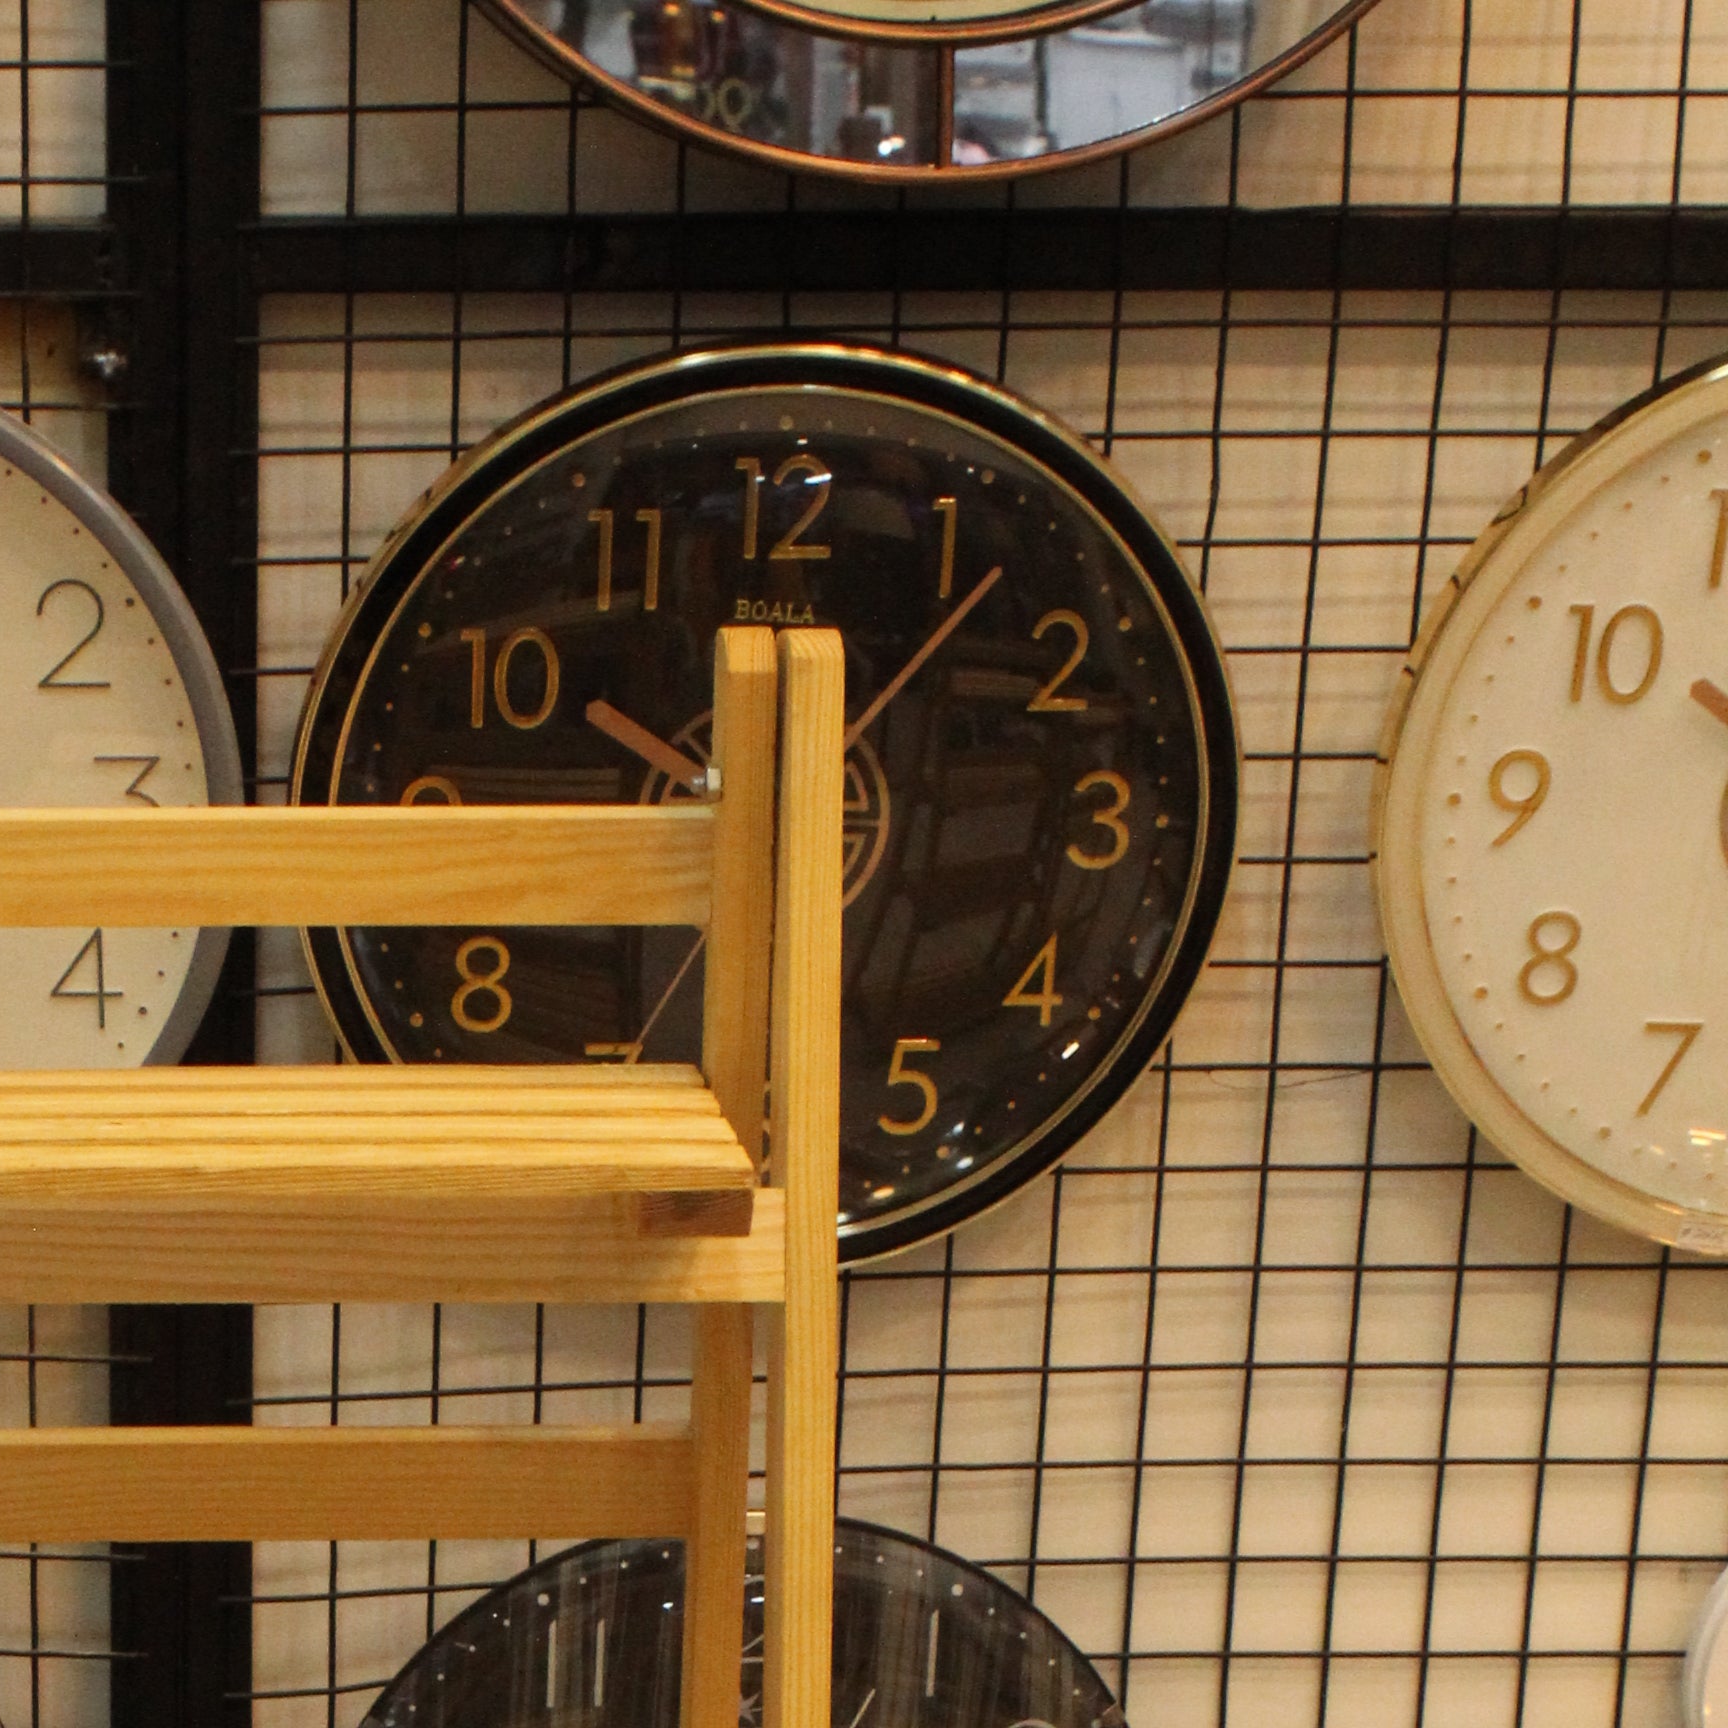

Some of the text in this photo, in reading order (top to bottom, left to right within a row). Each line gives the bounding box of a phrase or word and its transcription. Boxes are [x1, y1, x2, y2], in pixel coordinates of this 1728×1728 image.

[735, 455, 832, 560] 12
[932, 497, 958, 598] 1
[588, 509, 662, 610] 11
[38, 579, 112, 689] 2
[735, 597, 815, 624] BOALA
[1027, 609, 1089, 712] 2
[1569, 603, 1665, 707] 10
[461, 628, 560, 729] 10
[1066, 770, 1132, 870] 3
[1488, 749, 1552, 850] 9
[50, 928, 124, 1029] 4
[449, 937, 513, 1033] 8
[1002, 933, 1063, 1026] 4
[1519, 911, 1582, 1006] 8
[877, 1038, 942, 1136] 5
[1635, 1020, 1705, 1118] 7
[546, 1617, 606, 1708] 11
[925, 1609, 940, 1697] 1
